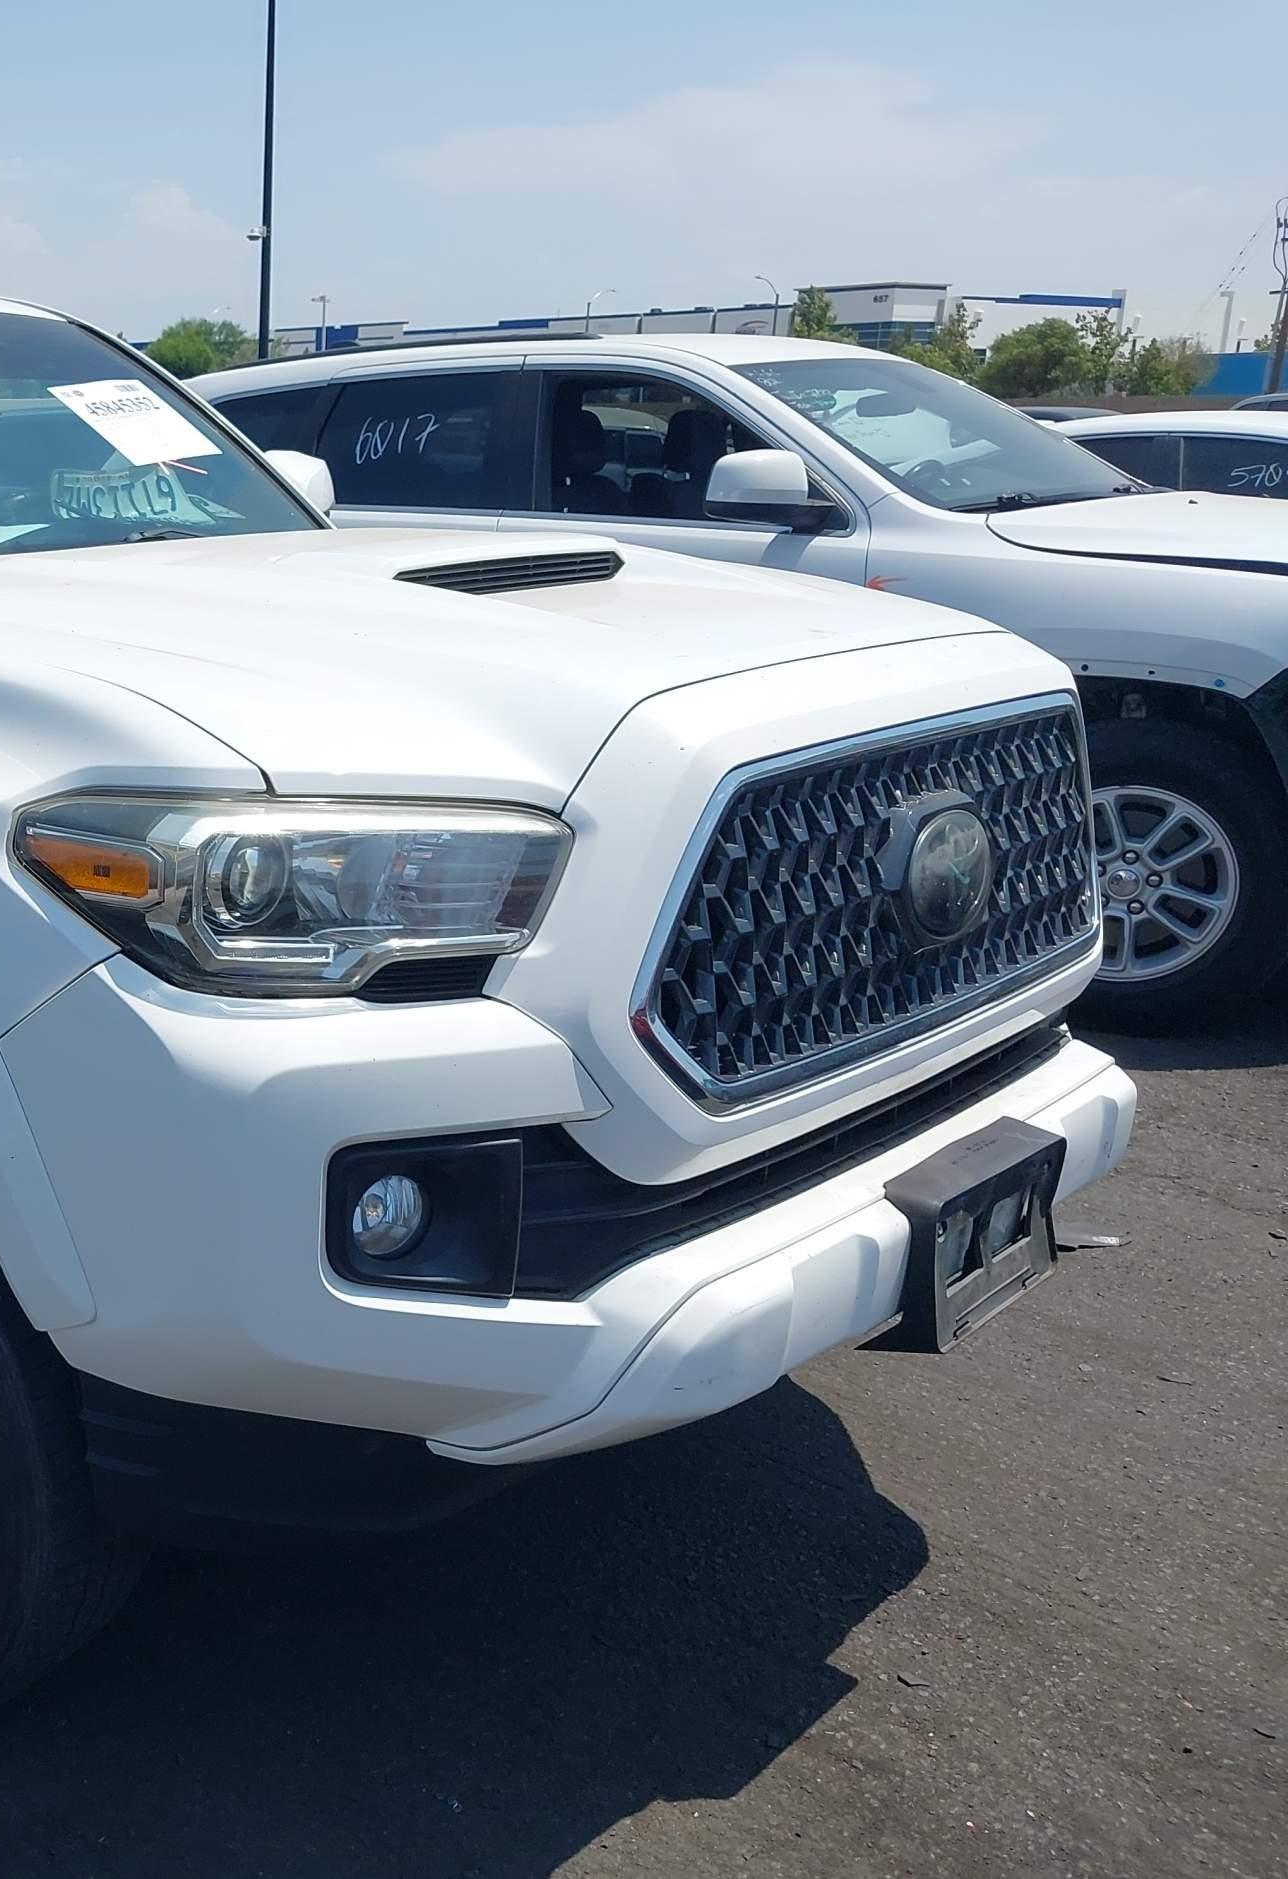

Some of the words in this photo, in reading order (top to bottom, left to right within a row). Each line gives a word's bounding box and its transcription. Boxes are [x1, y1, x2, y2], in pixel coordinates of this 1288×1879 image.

[85, 397, 160, 417] 45845352
[355, 413, 440, 464] 6017
[1227, 462, 1288, 488] 570
